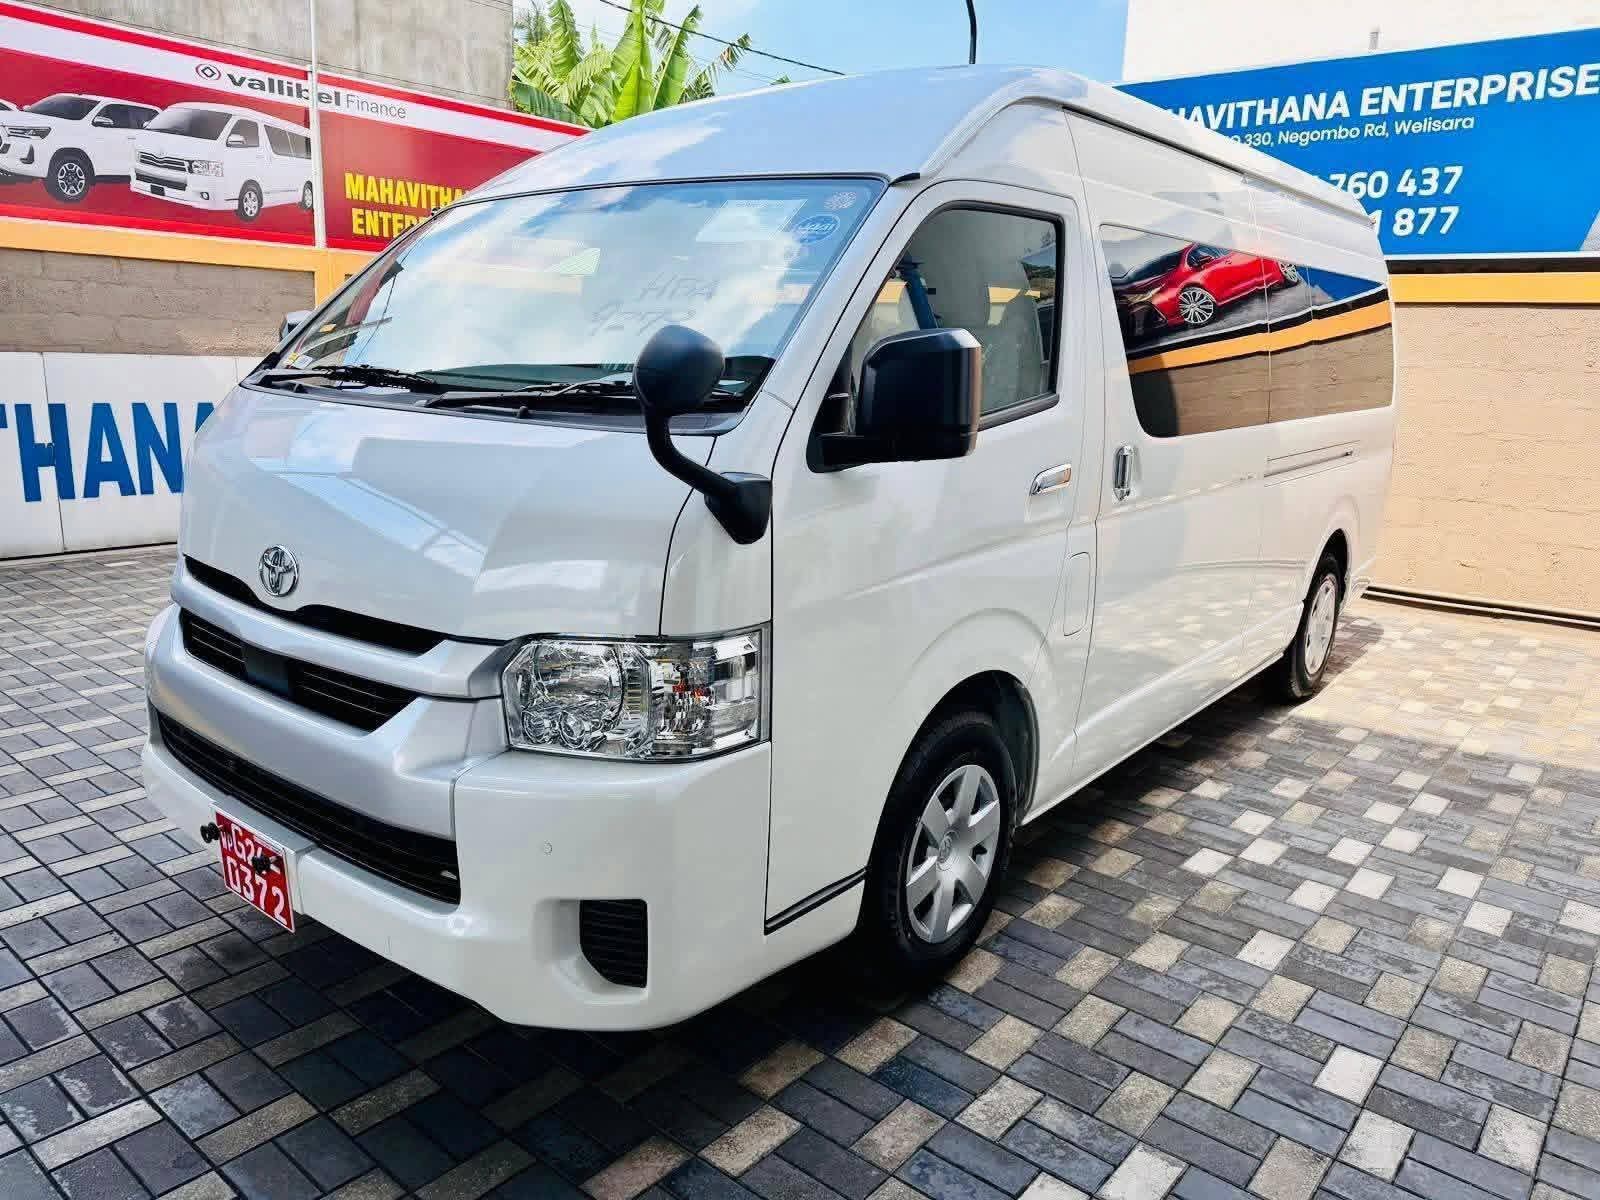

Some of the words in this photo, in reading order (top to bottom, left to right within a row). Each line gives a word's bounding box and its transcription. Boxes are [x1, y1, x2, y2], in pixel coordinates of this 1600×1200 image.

[1360, 63, 1600, 116] ENTERPRISE
[346, 94, 406, 119] Finance
[1278, 125, 1360, 147] Negombo
[1364, 122, 1390, 138] Rd,
[1394, 116, 1475, 135] Welisara
[1396, 165, 1463, 197] 437
[1392, 206, 1460, 237] 877
[0, 401, 215, 503] HAN
[226, 855, 288, 926] 0372
